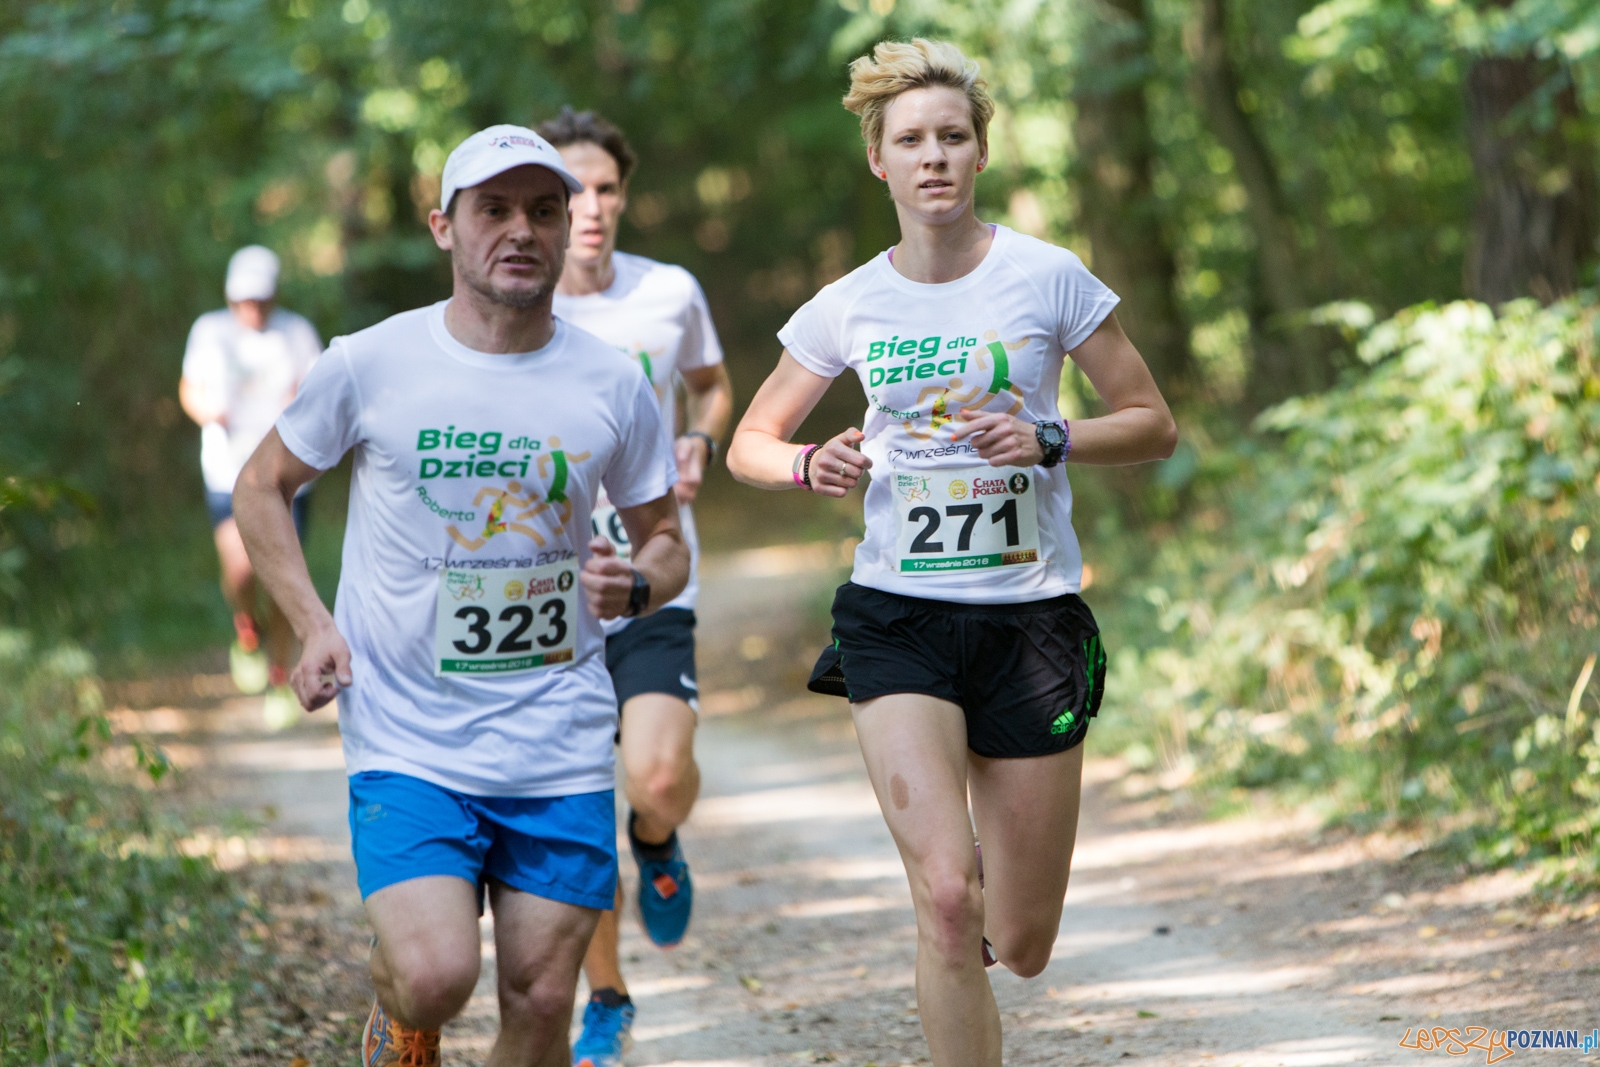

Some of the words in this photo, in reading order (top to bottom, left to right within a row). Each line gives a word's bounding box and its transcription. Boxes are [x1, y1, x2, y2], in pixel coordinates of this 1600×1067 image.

[867, 335, 941, 362] Bieg
[946, 336, 977, 350] dla
[869, 351, 969, 388] Dzieci
[871, 394, 921, 420] Roberta
[416, 426, 502, 455] Bieg
[508, 436, 541, 450] dla
[419, 454, 531, 479] Dzieci
[887, 450, 902, 463] 17
[972, 486, 1009, 499] POLSKA
[973, 477, 1006, 488] CHATA
[415, 486, 475, 522] Roberta
[907, 498, 1020, 554] 271
[421, 556, 443, 571] 17
[444, 553, 533, 570] września
[913, 561, 925, 569] 17
[962, 557, 990, 567] 2016
[452, 598, 568, 655] 323
